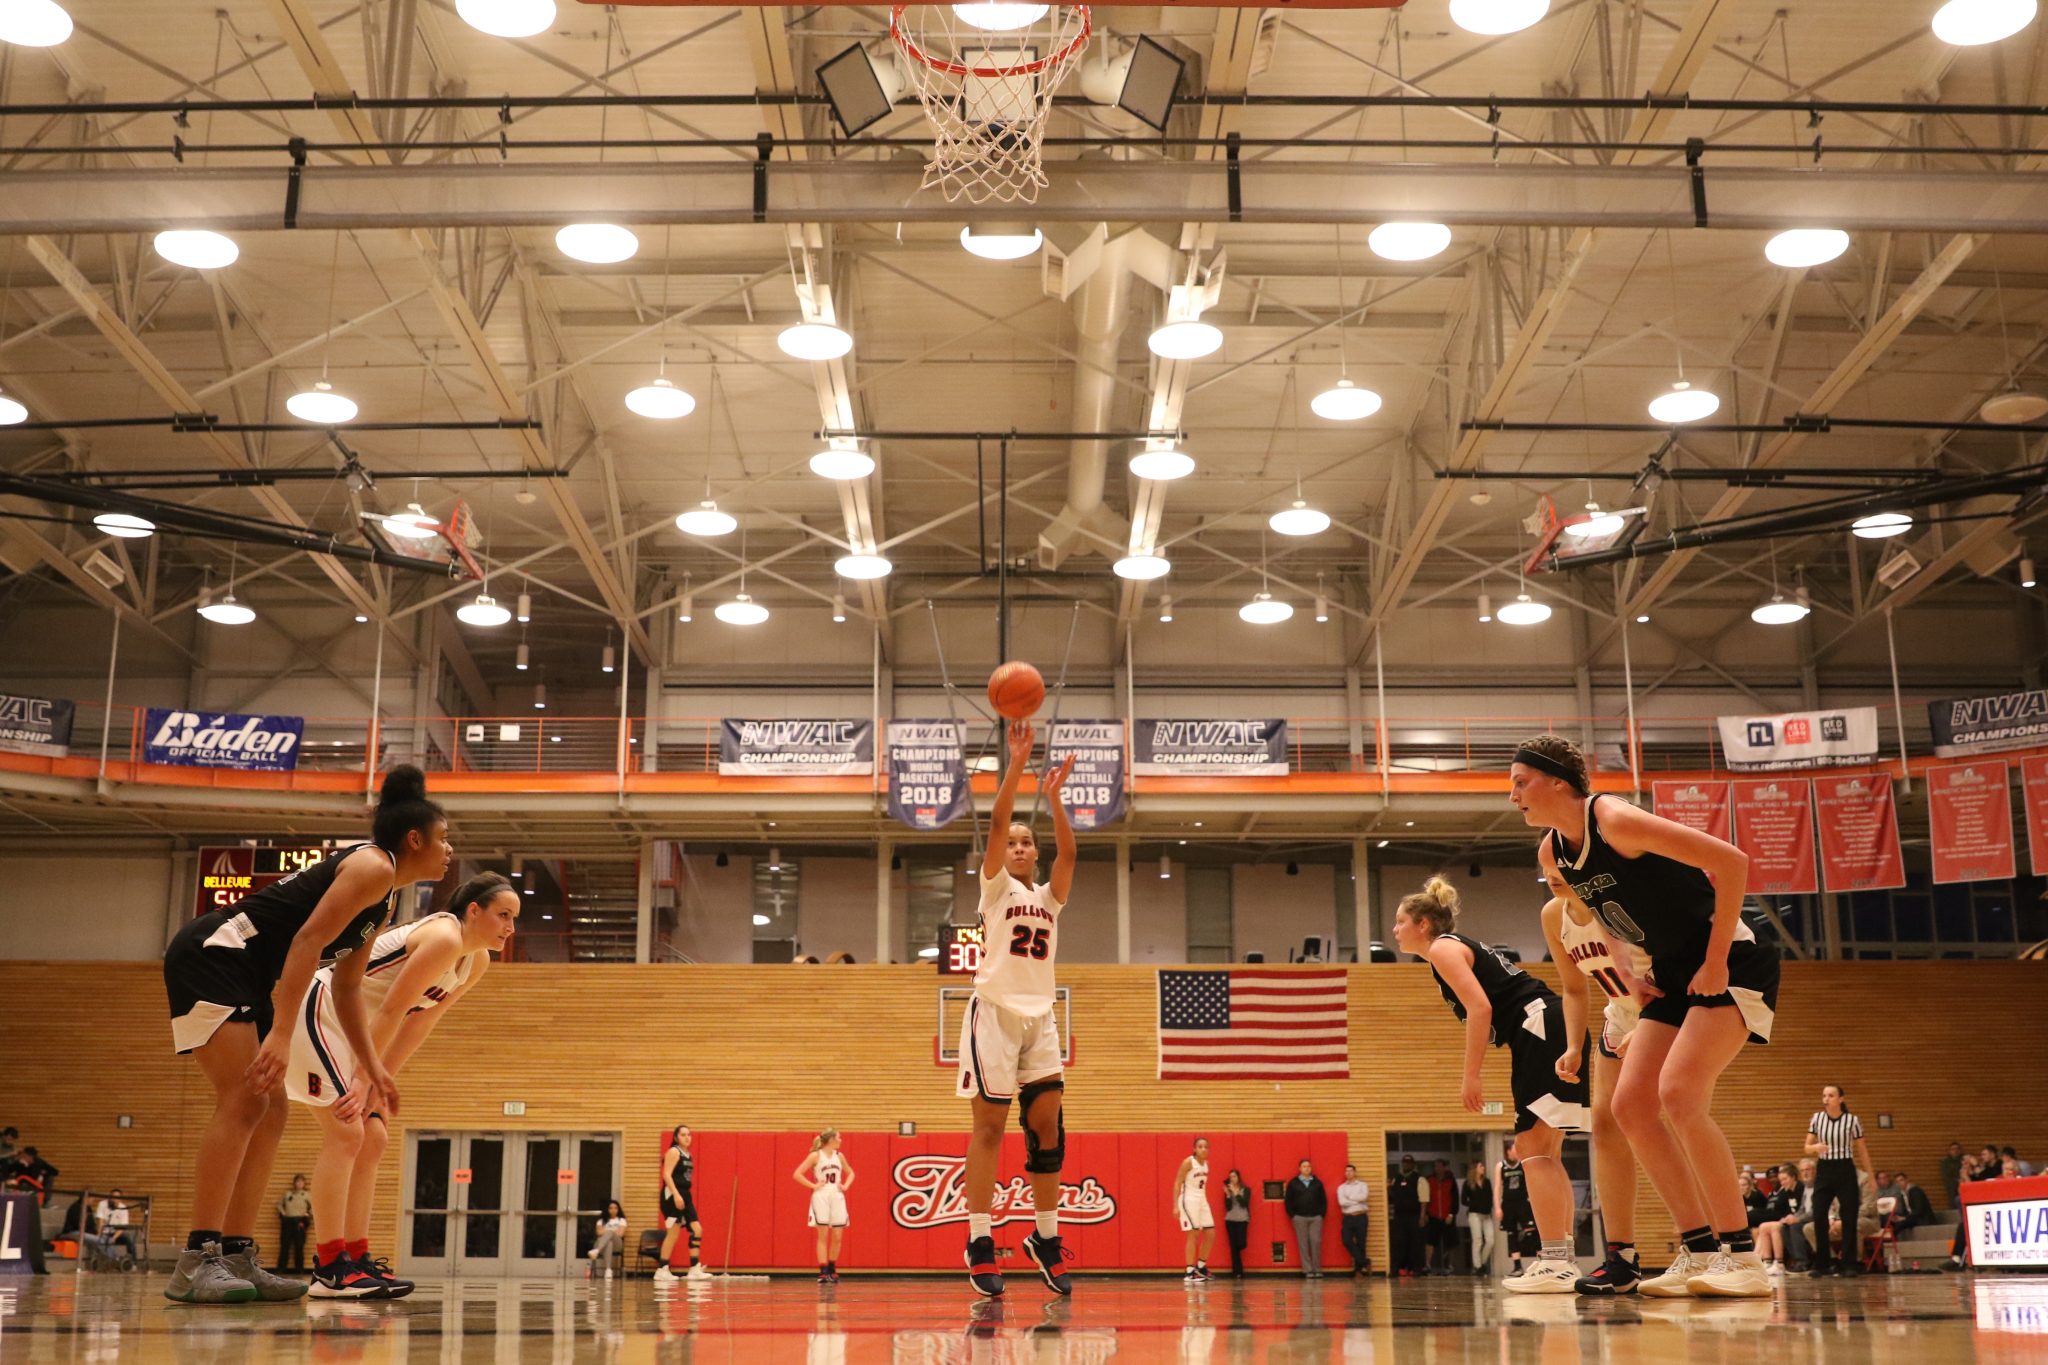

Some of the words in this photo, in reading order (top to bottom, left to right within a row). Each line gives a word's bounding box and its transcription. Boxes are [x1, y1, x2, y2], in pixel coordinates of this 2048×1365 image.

[740, 721, 855, 746] NWAC
[900, 728, 954, 738] NWAC
[1057, 728, 1112, 739] NWAC
[1152, 721, 1267, 746] NWAC
[168, 748, 234, 760] OFFICIAL
[240, 752, 277, 761] BALL
[740, 753, 856, 763] CHAMPIONSHIP
[892, 748, 961, 760] CHAMPIONS
[1153, 753, 1269, 763] CHAMPIONSHIP
[1074, 763, 1095, 772] MENS
[899, 773, 954, 784] BASKETBALL
[901, 786, 952, 804] 2018
[1060, 786, 1110, 805] 2018
[280, 850, 322, 872] 1:42
[204, 876, 252, 888] BELLEVUE
[1009, 924, 1051, 961] 25
[949, 944, 980, 971] 30
[1590, 966, 1631, 998] 11
[308, 1072, 322, 1098] B
[962, 1070, 971, 1089] B
